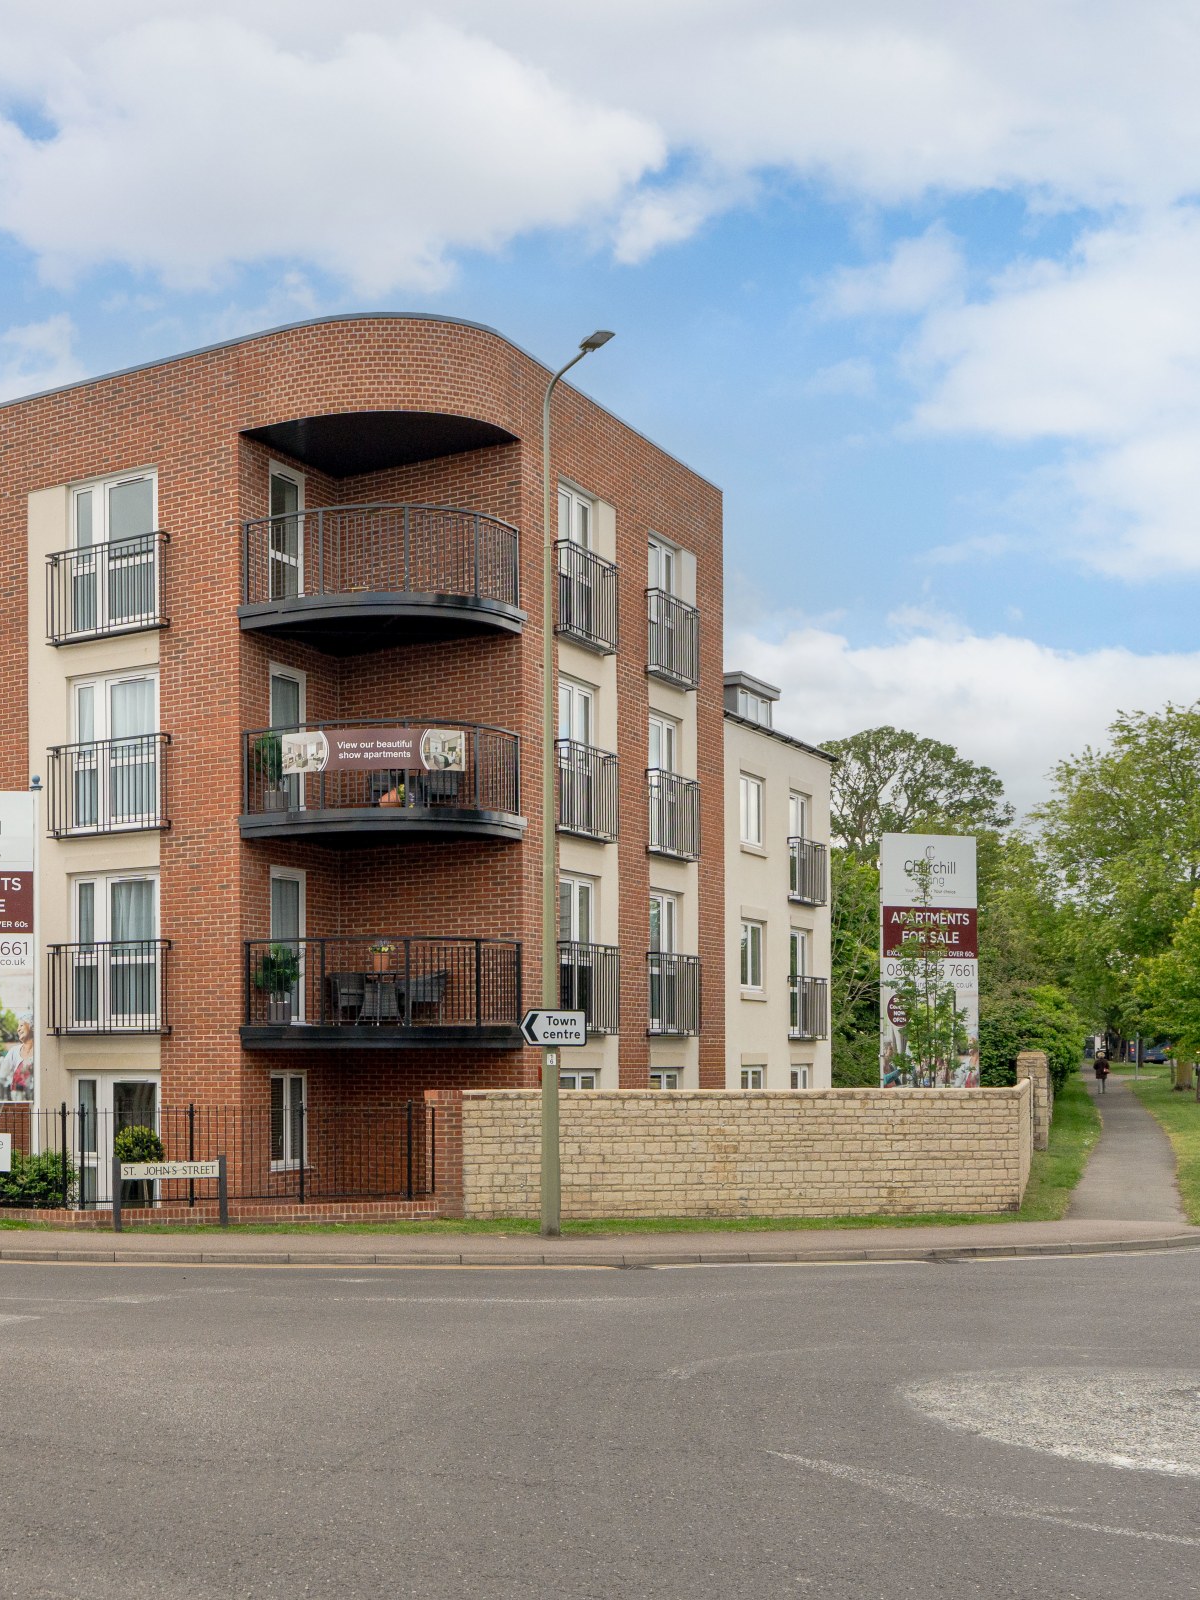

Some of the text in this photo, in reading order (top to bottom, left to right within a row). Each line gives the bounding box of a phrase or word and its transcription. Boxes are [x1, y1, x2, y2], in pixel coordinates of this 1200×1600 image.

[337, 741, 358, 749] View
[376, 740, 413, 748] beautiful
[338, 750, 411, 760] show apartments
[930, 932, 960, 943] SALE
[949, 964, 975, 977] 7661
[546, 1016, 576, 1026] Town
[543, 1030, 581, 1039] centre
[123, 1166, 136, 1176] ST.
[182, 1165, 215, 1175] STREET
